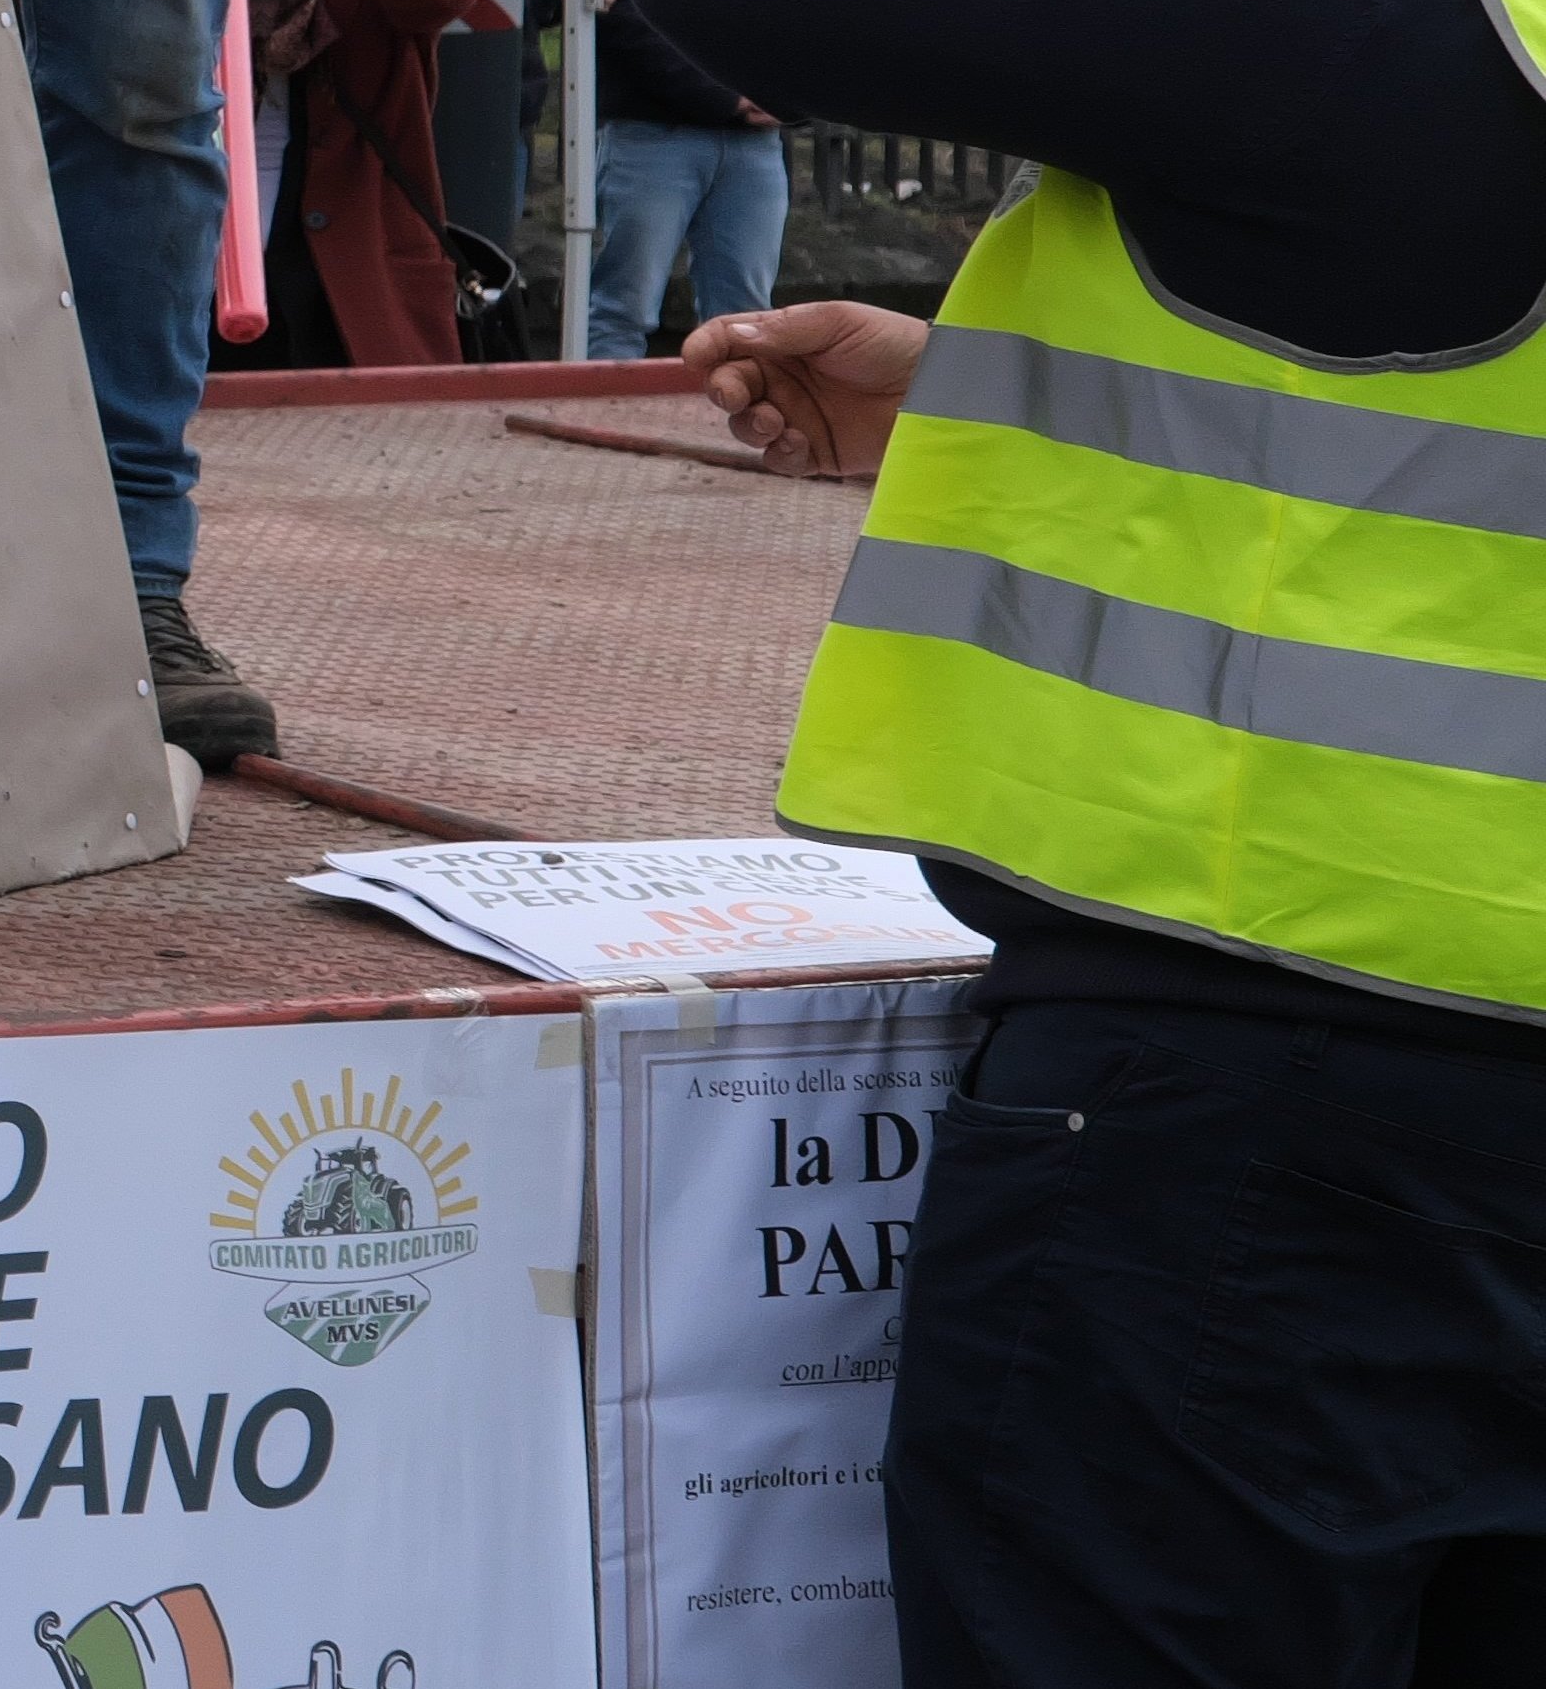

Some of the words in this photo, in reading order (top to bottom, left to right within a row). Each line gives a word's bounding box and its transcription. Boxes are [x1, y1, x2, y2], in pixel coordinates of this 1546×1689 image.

[393, 848, 842, 875] PROTESTIAMO
[424, 866, 610, 891] TUTTI
[467, 887, 597, 909] PER
[614, 880, 697, 902] UN
[642, 900, 814, 937] NO
[594, 925, 961, 962] MERCOSUR
[687, 1077, 704, 1100] A
[708, 1072, 790, 1103] seguito
[796, 1068, 846, 1093] della
[853, 1070, 922, 1090] scossa
[770, 1118, 834, 1188] la
[215, 1244, 328, 1271] COMITATO
[336, 1229, 474, 1270] AGRICOLTORI
[284, 1294, 417, 1320] AVELLINESI
[326, 1322, 380, 1344] MVS
[782, 1361, 824, 1382] con
[685, 1472, 712, 1500] gli
[720, 1464, 828, 1498] agricoltori
[835, 1469, 846, 1484] e
[852, 1463, 859, 1484] i
[687, 1584, 782, 1612] resistere,
